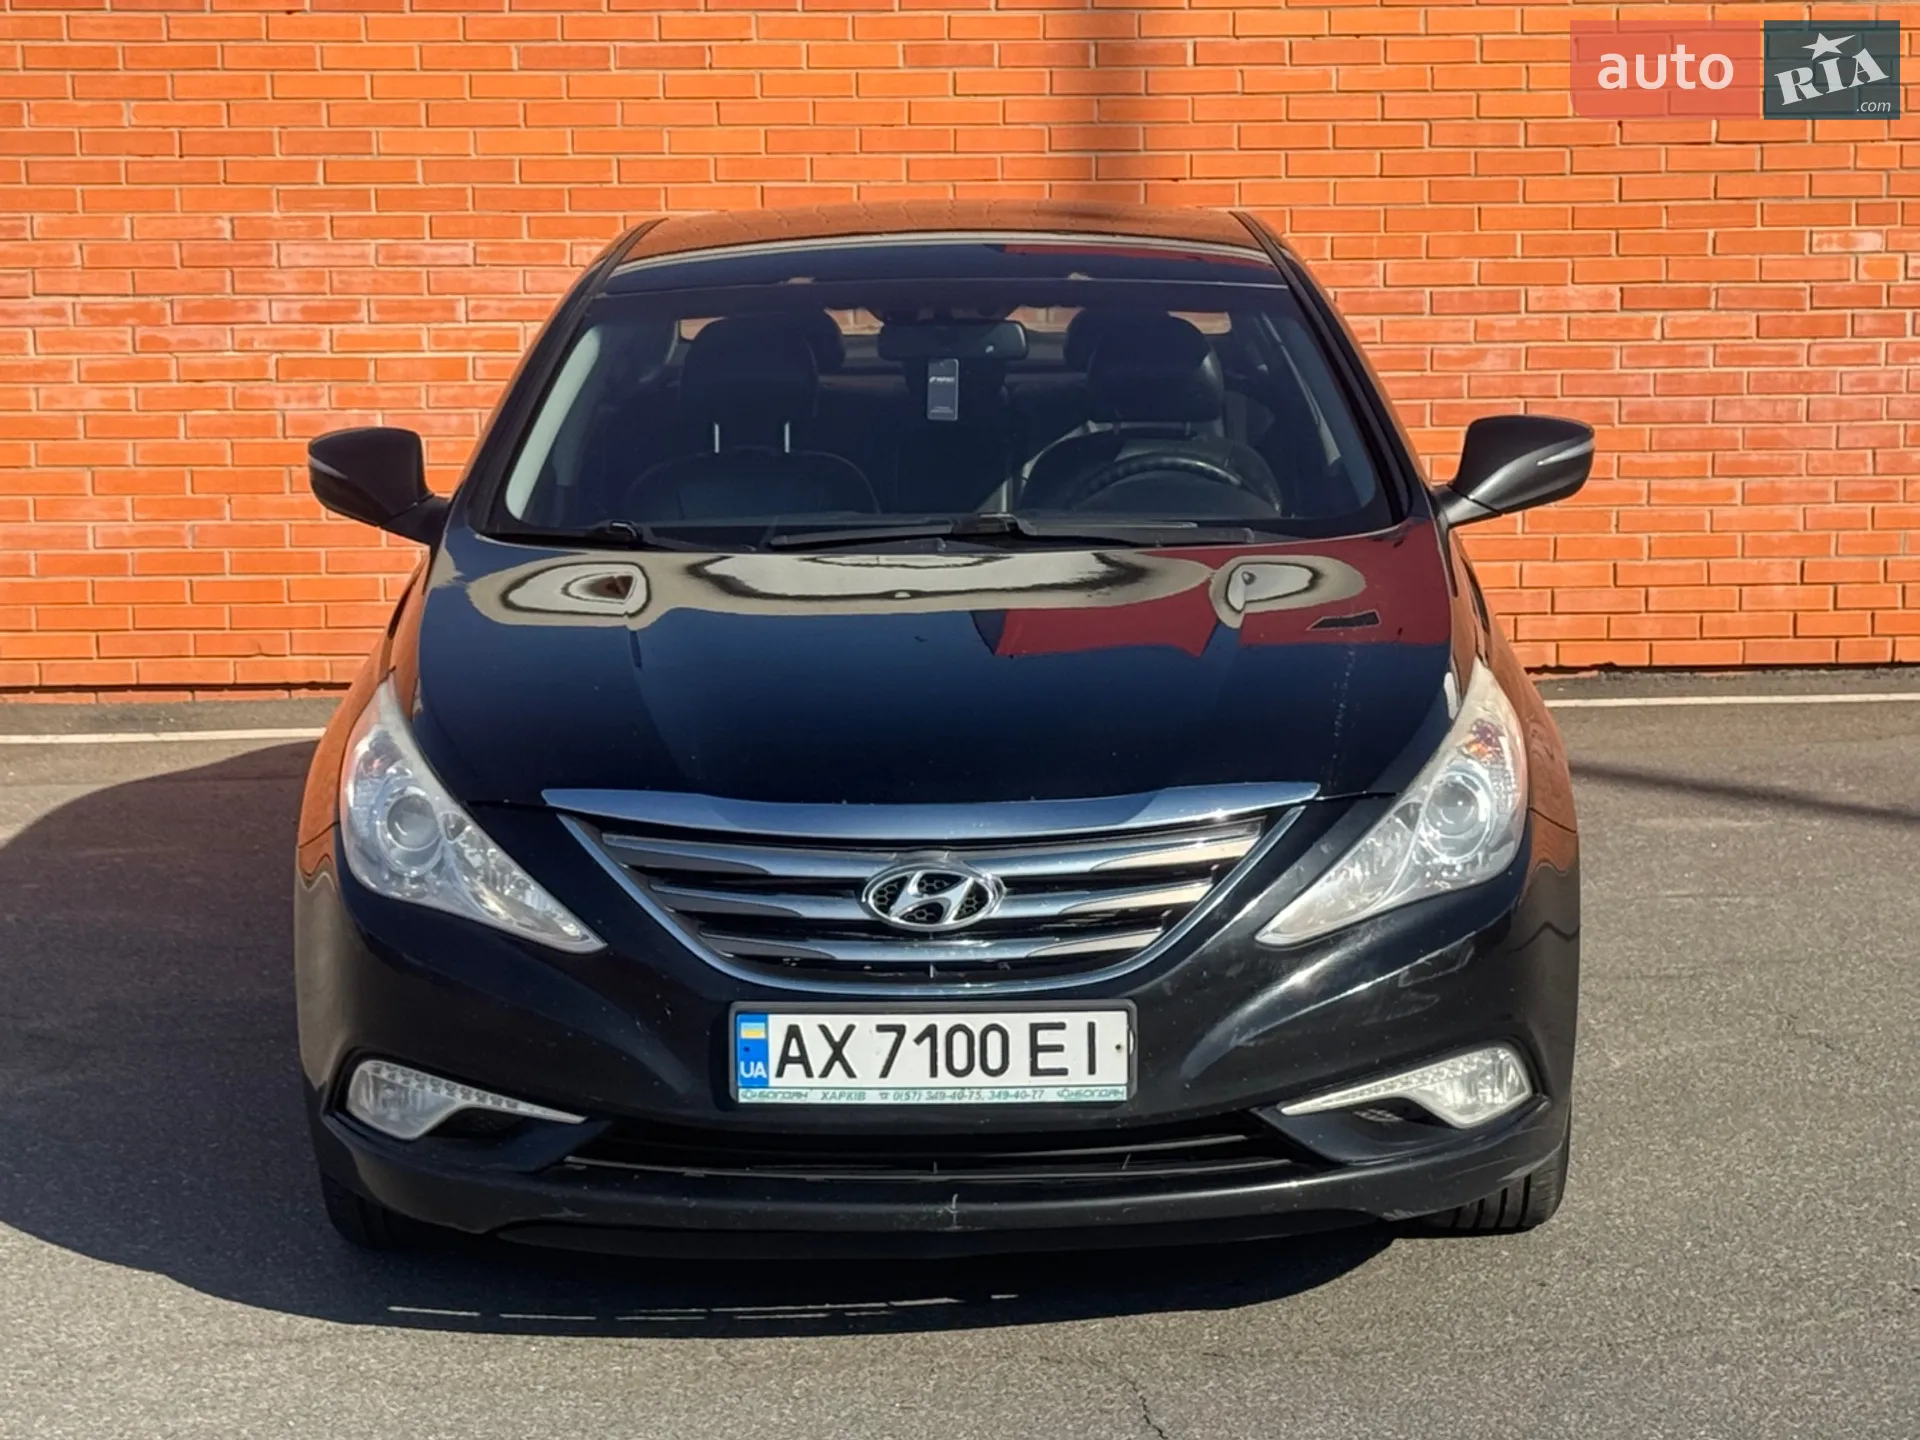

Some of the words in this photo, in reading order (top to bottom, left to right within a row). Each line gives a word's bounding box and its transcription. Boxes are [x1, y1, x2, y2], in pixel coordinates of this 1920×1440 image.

[775, 1023, 857, 1079] AX
[875, 1023, 1010, 1078] 7100
[1029, 1021, 1096, 1077] EI
[740, 1061, 768, 1078] UA
